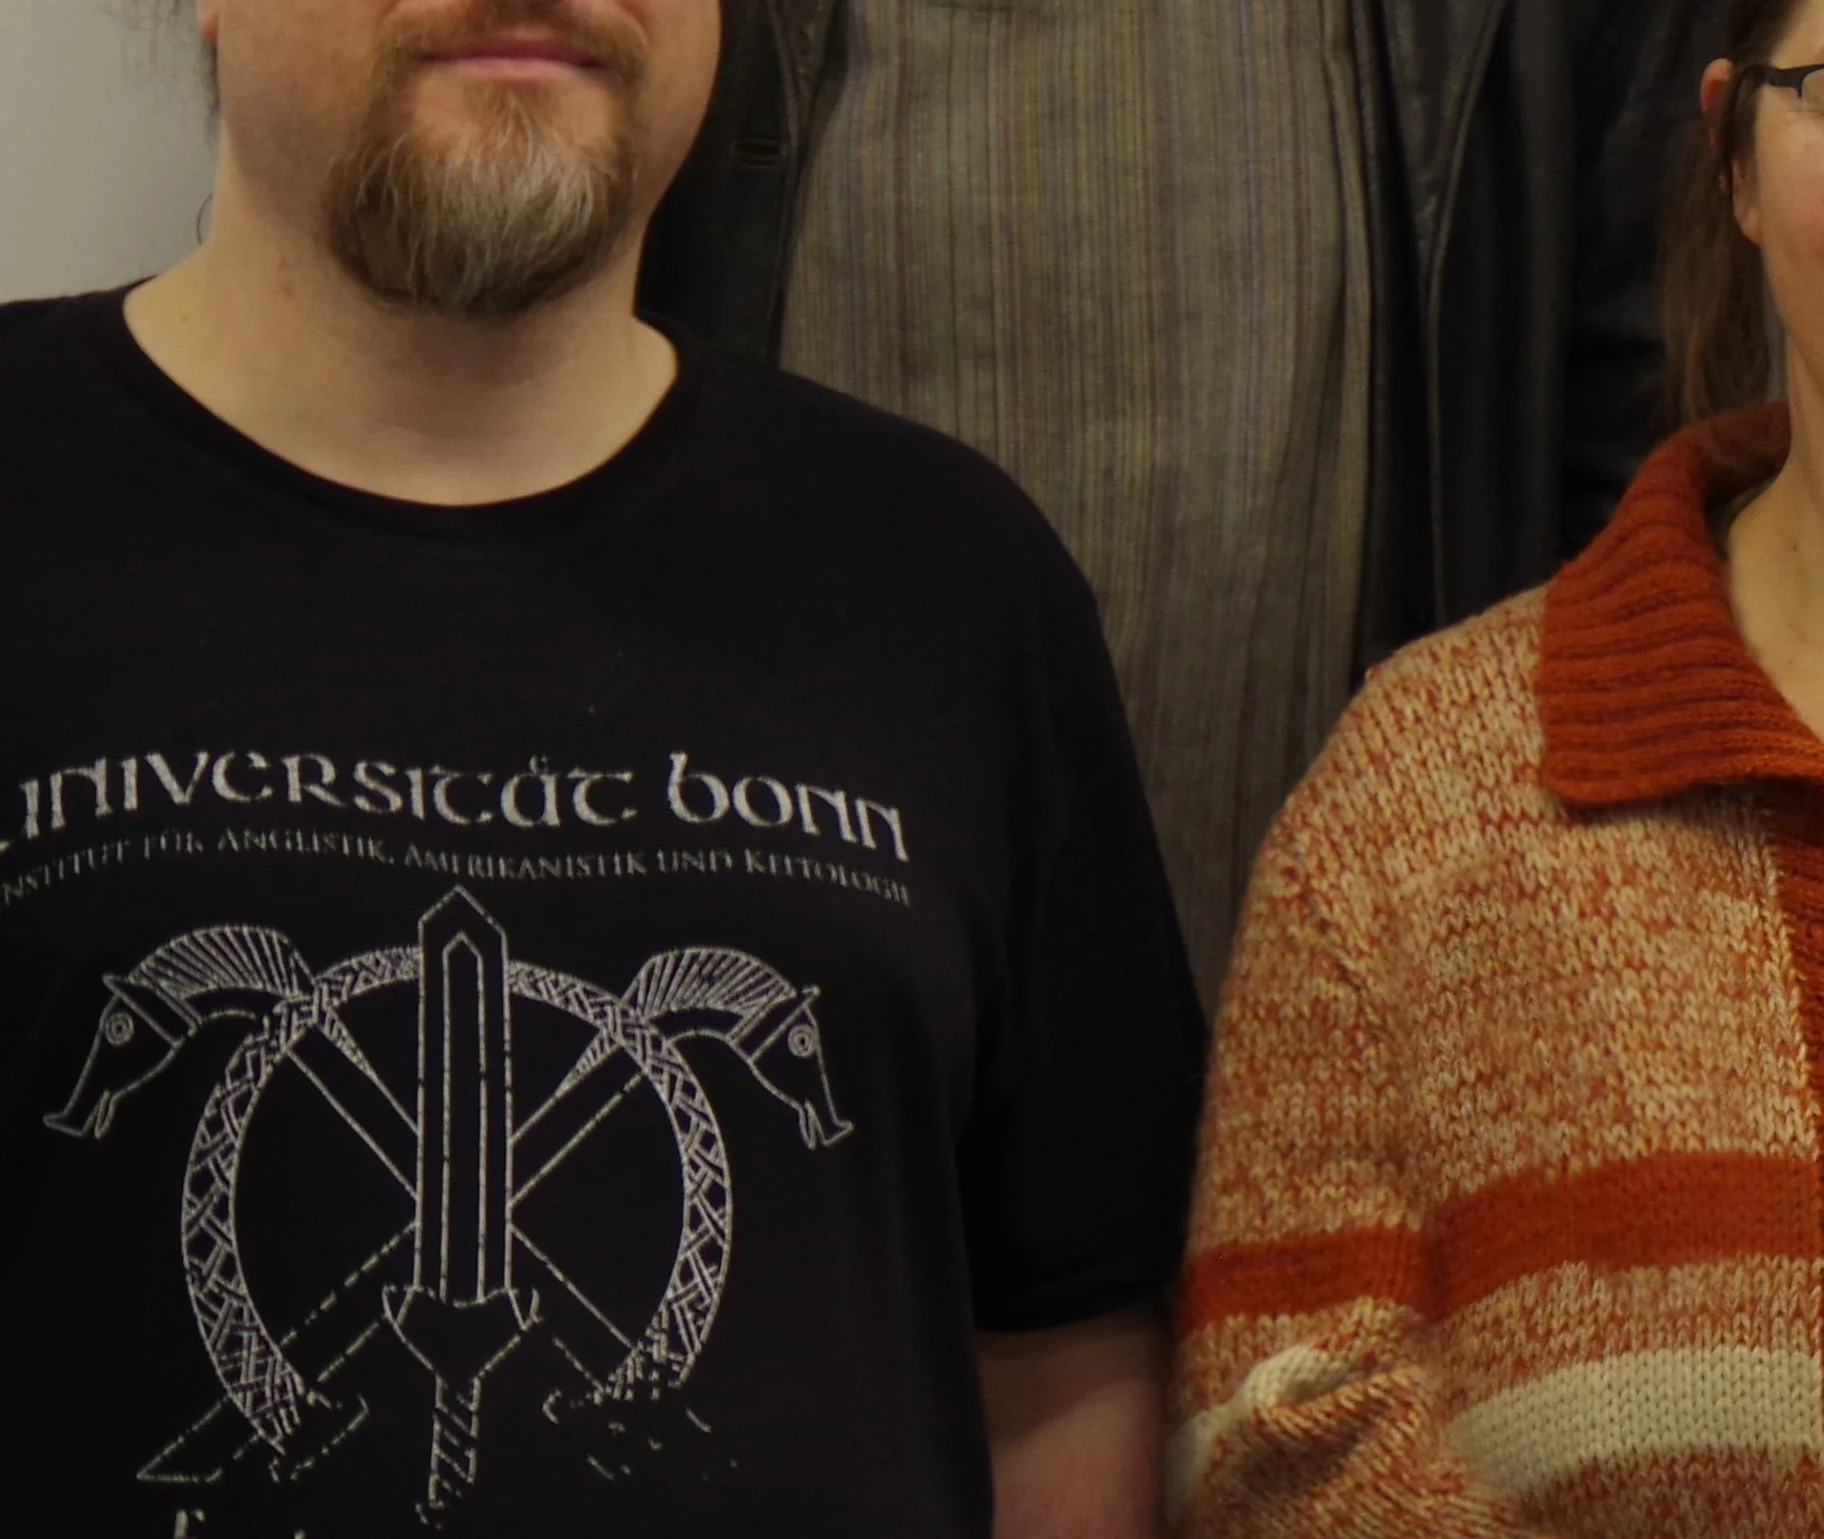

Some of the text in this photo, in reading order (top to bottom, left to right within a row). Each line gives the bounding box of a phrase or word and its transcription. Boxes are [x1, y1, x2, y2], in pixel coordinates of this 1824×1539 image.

[1, 837, 130, 906] NSTITUT
[144, 828, 205, 860] FÜR
[404, 841, 648, 880] AMERIKANISTIK
[656, 848, 733, 873] UND
